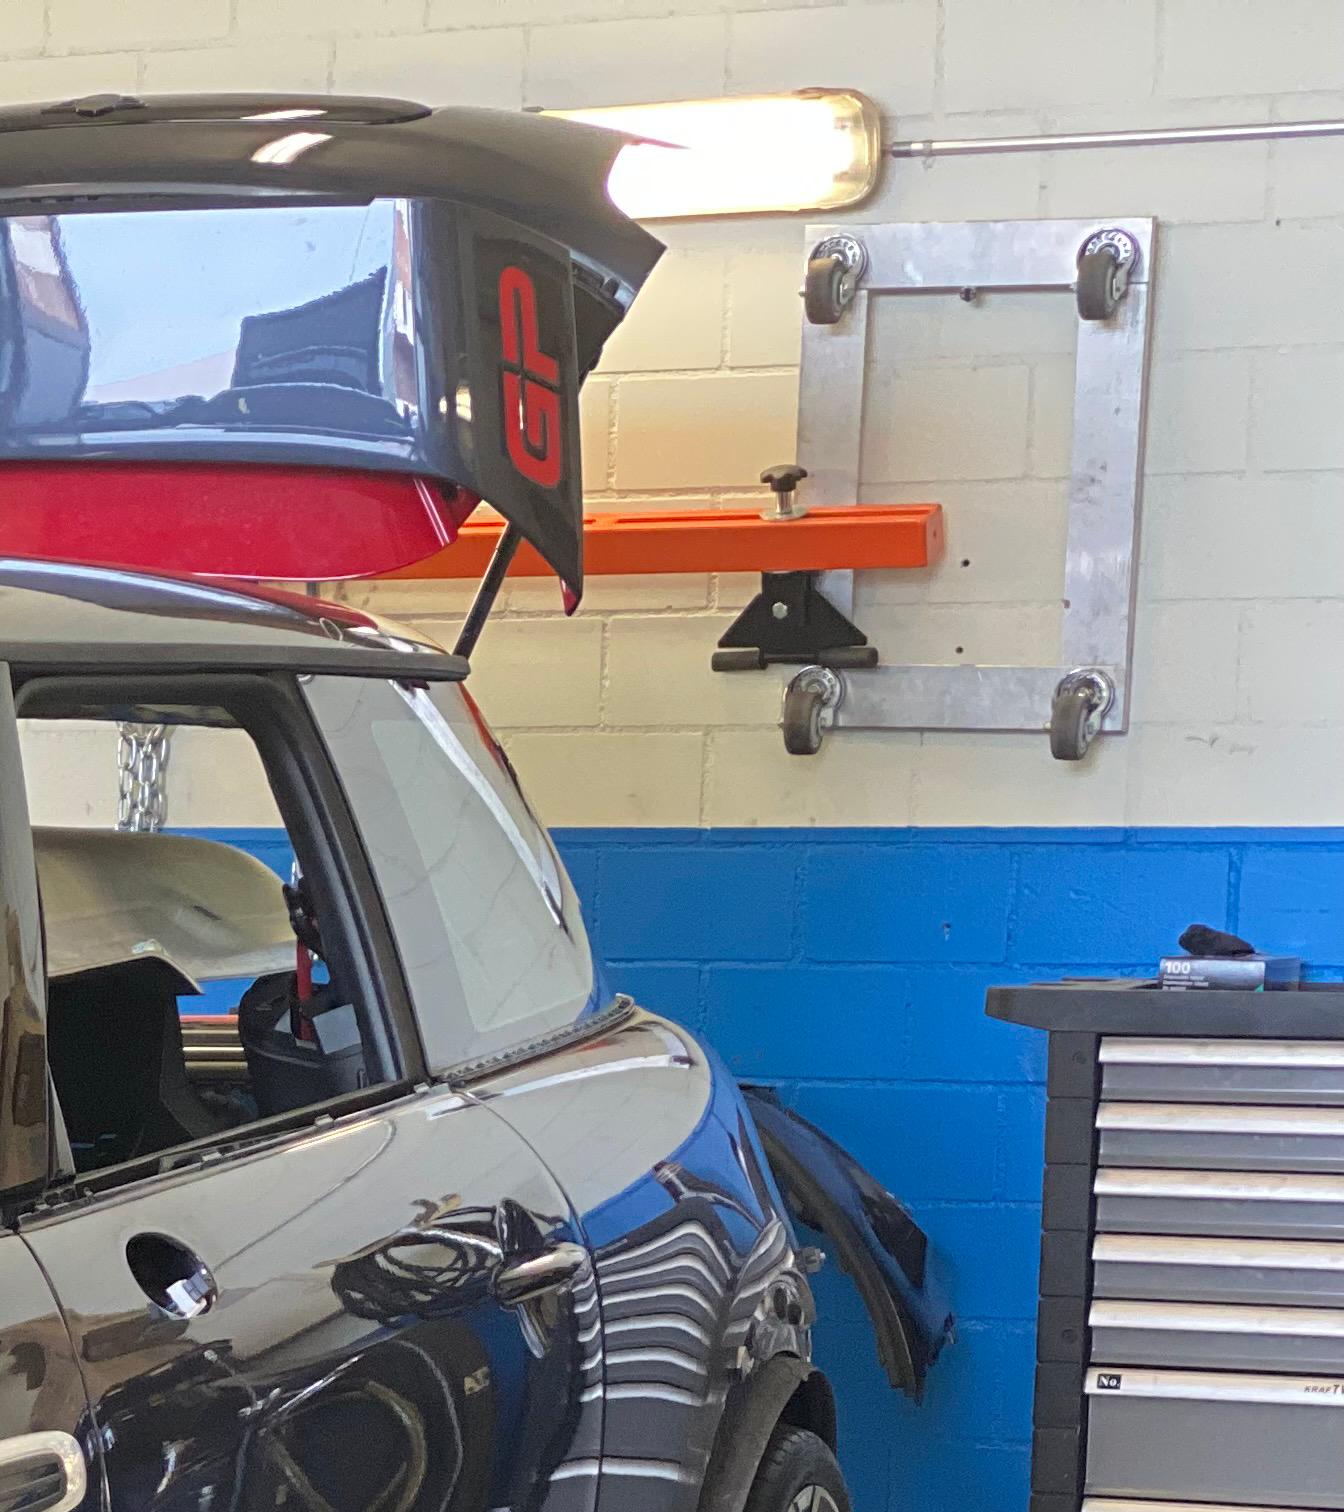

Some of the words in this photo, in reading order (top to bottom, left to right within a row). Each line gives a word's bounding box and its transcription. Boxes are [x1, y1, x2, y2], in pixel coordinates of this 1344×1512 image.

[499, 265, 561, 488] GP
[1165, 961, 1191, 974] 100
[1098, 1375, 1121, 1387] No.
[1304, 1383, 1344, 1395] KRAFT
